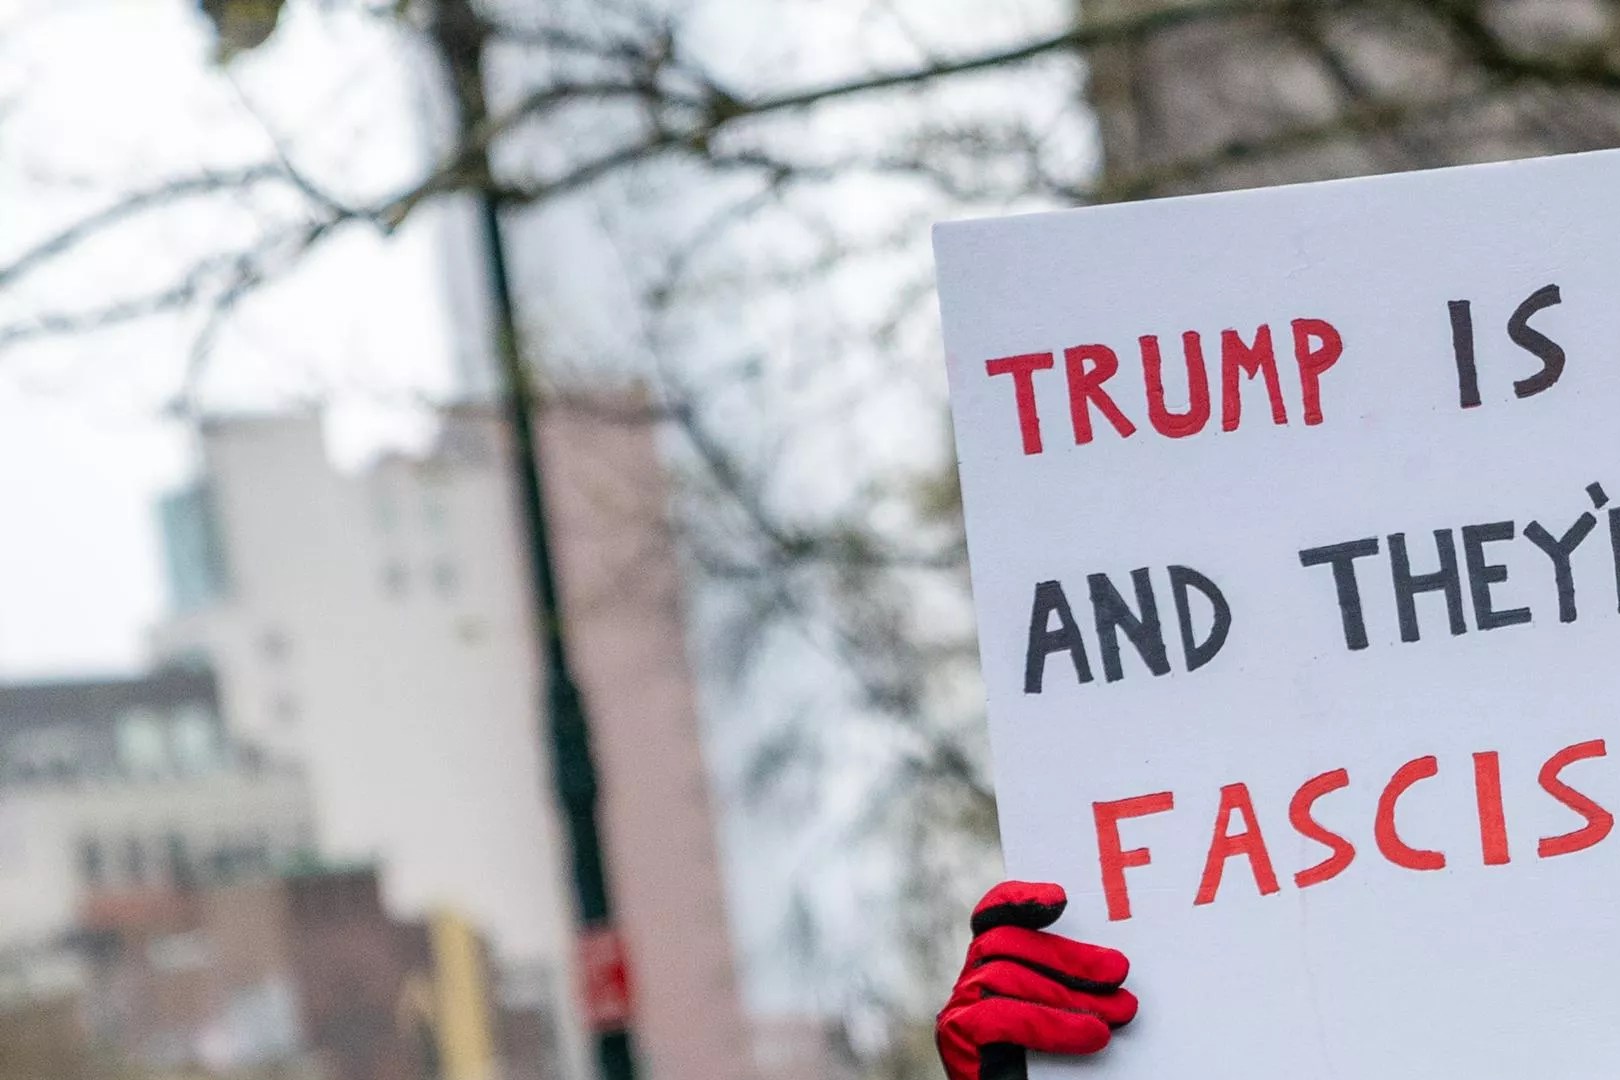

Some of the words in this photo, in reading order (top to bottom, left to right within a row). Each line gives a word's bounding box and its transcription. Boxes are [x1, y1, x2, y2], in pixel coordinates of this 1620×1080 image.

[984, 317, 1344, 456] TRUMP
[1447, 283, 1566, 409] IS
[1023, 564, 1232, 694] AND
